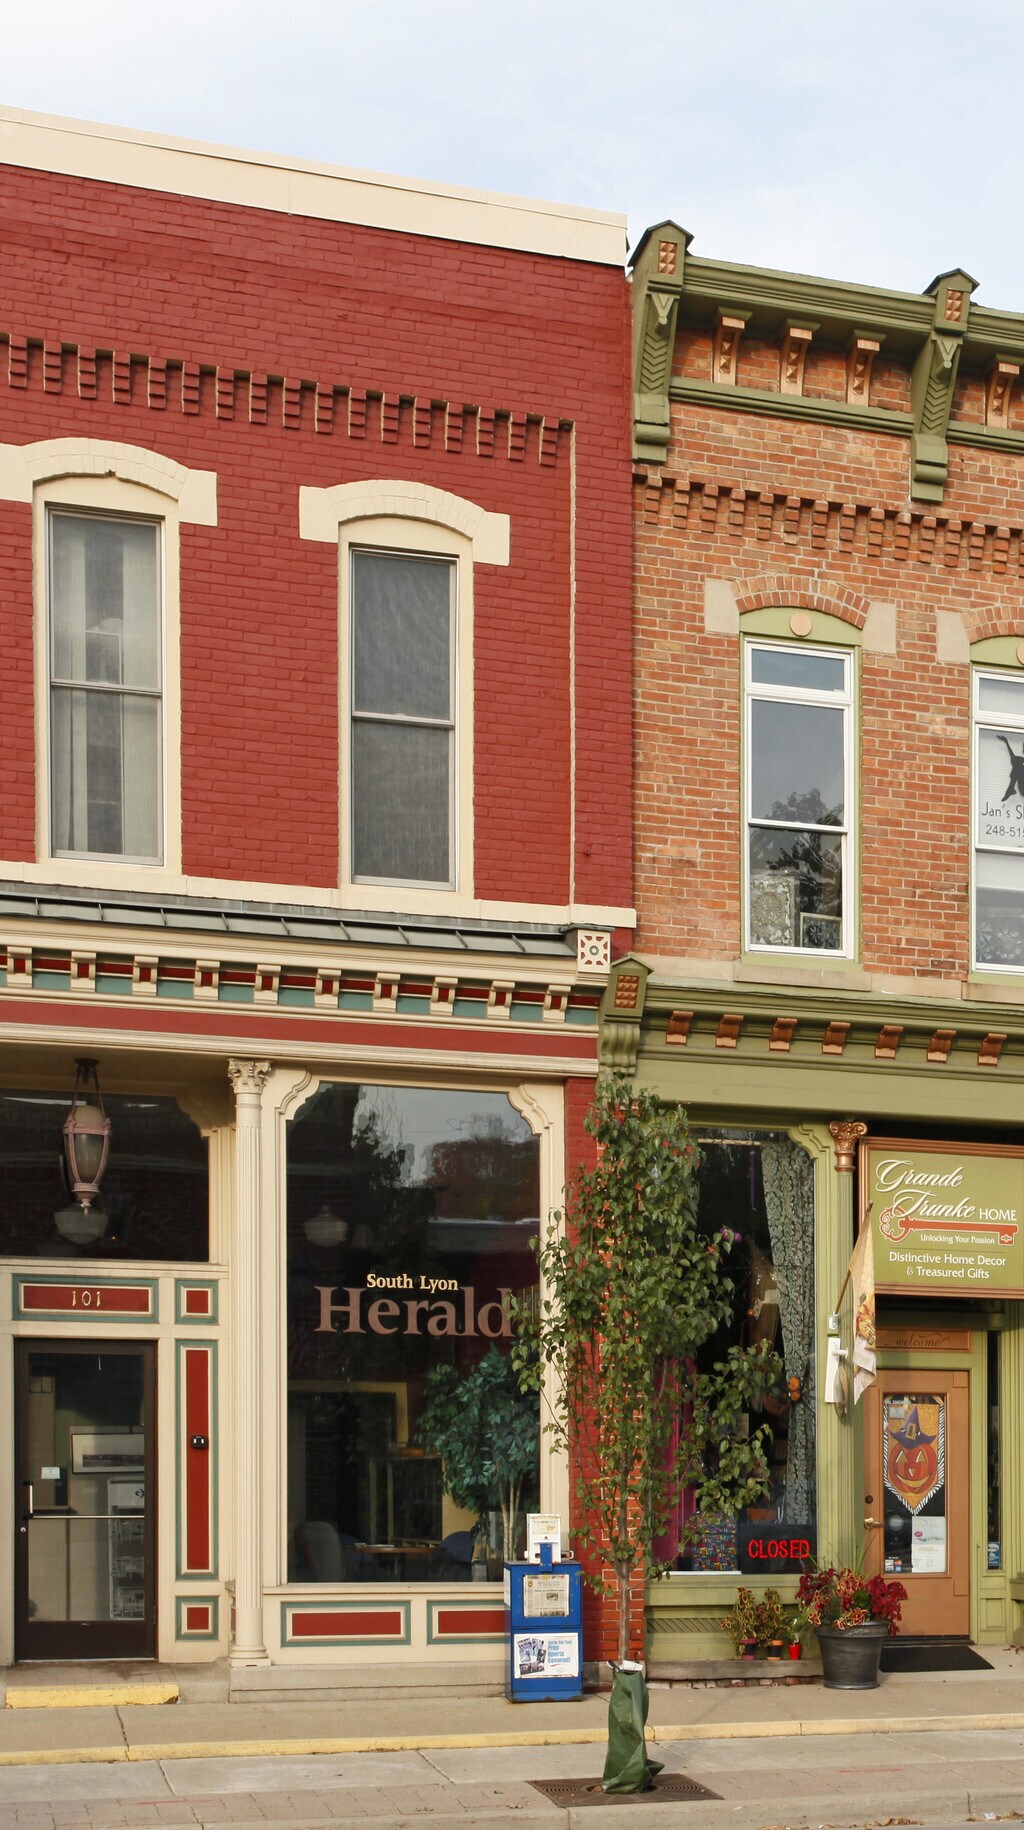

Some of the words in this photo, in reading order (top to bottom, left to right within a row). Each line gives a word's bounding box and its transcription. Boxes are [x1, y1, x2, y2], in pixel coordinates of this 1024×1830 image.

[981, 801, 1011, 818] Jan's
[875, 1159, 964, 1192] Grande
[892, 1189, 976, 1218] Trunke
[979, 1208, 1017, 1221] HOME
[920, 1234, 953, 1245] Unlocking
[955, 1234, 969, 1243] Your
[971, 1236, 995, 1244] Passion
[889, 1251, 942, 1263] Distinctive
[944, 1254, 974, 1265] Home
[977, 1255, 1006, 1266] Decor
[906, 1266, 914, 1276] &
[916, 1266, 965, 1278] Treasured
[967, 1268, 990, 1279] Gifts
[366, 1273, 414, 1289] South
[419, 1275, 459, 1293] Lyon
[71, 1290, 101, 1307] 101
[313, 1285, 516, 1338] Herald
[893, 1332, 948, 1347] welcome
[747, 1539, 811, 1559] CLOSED
